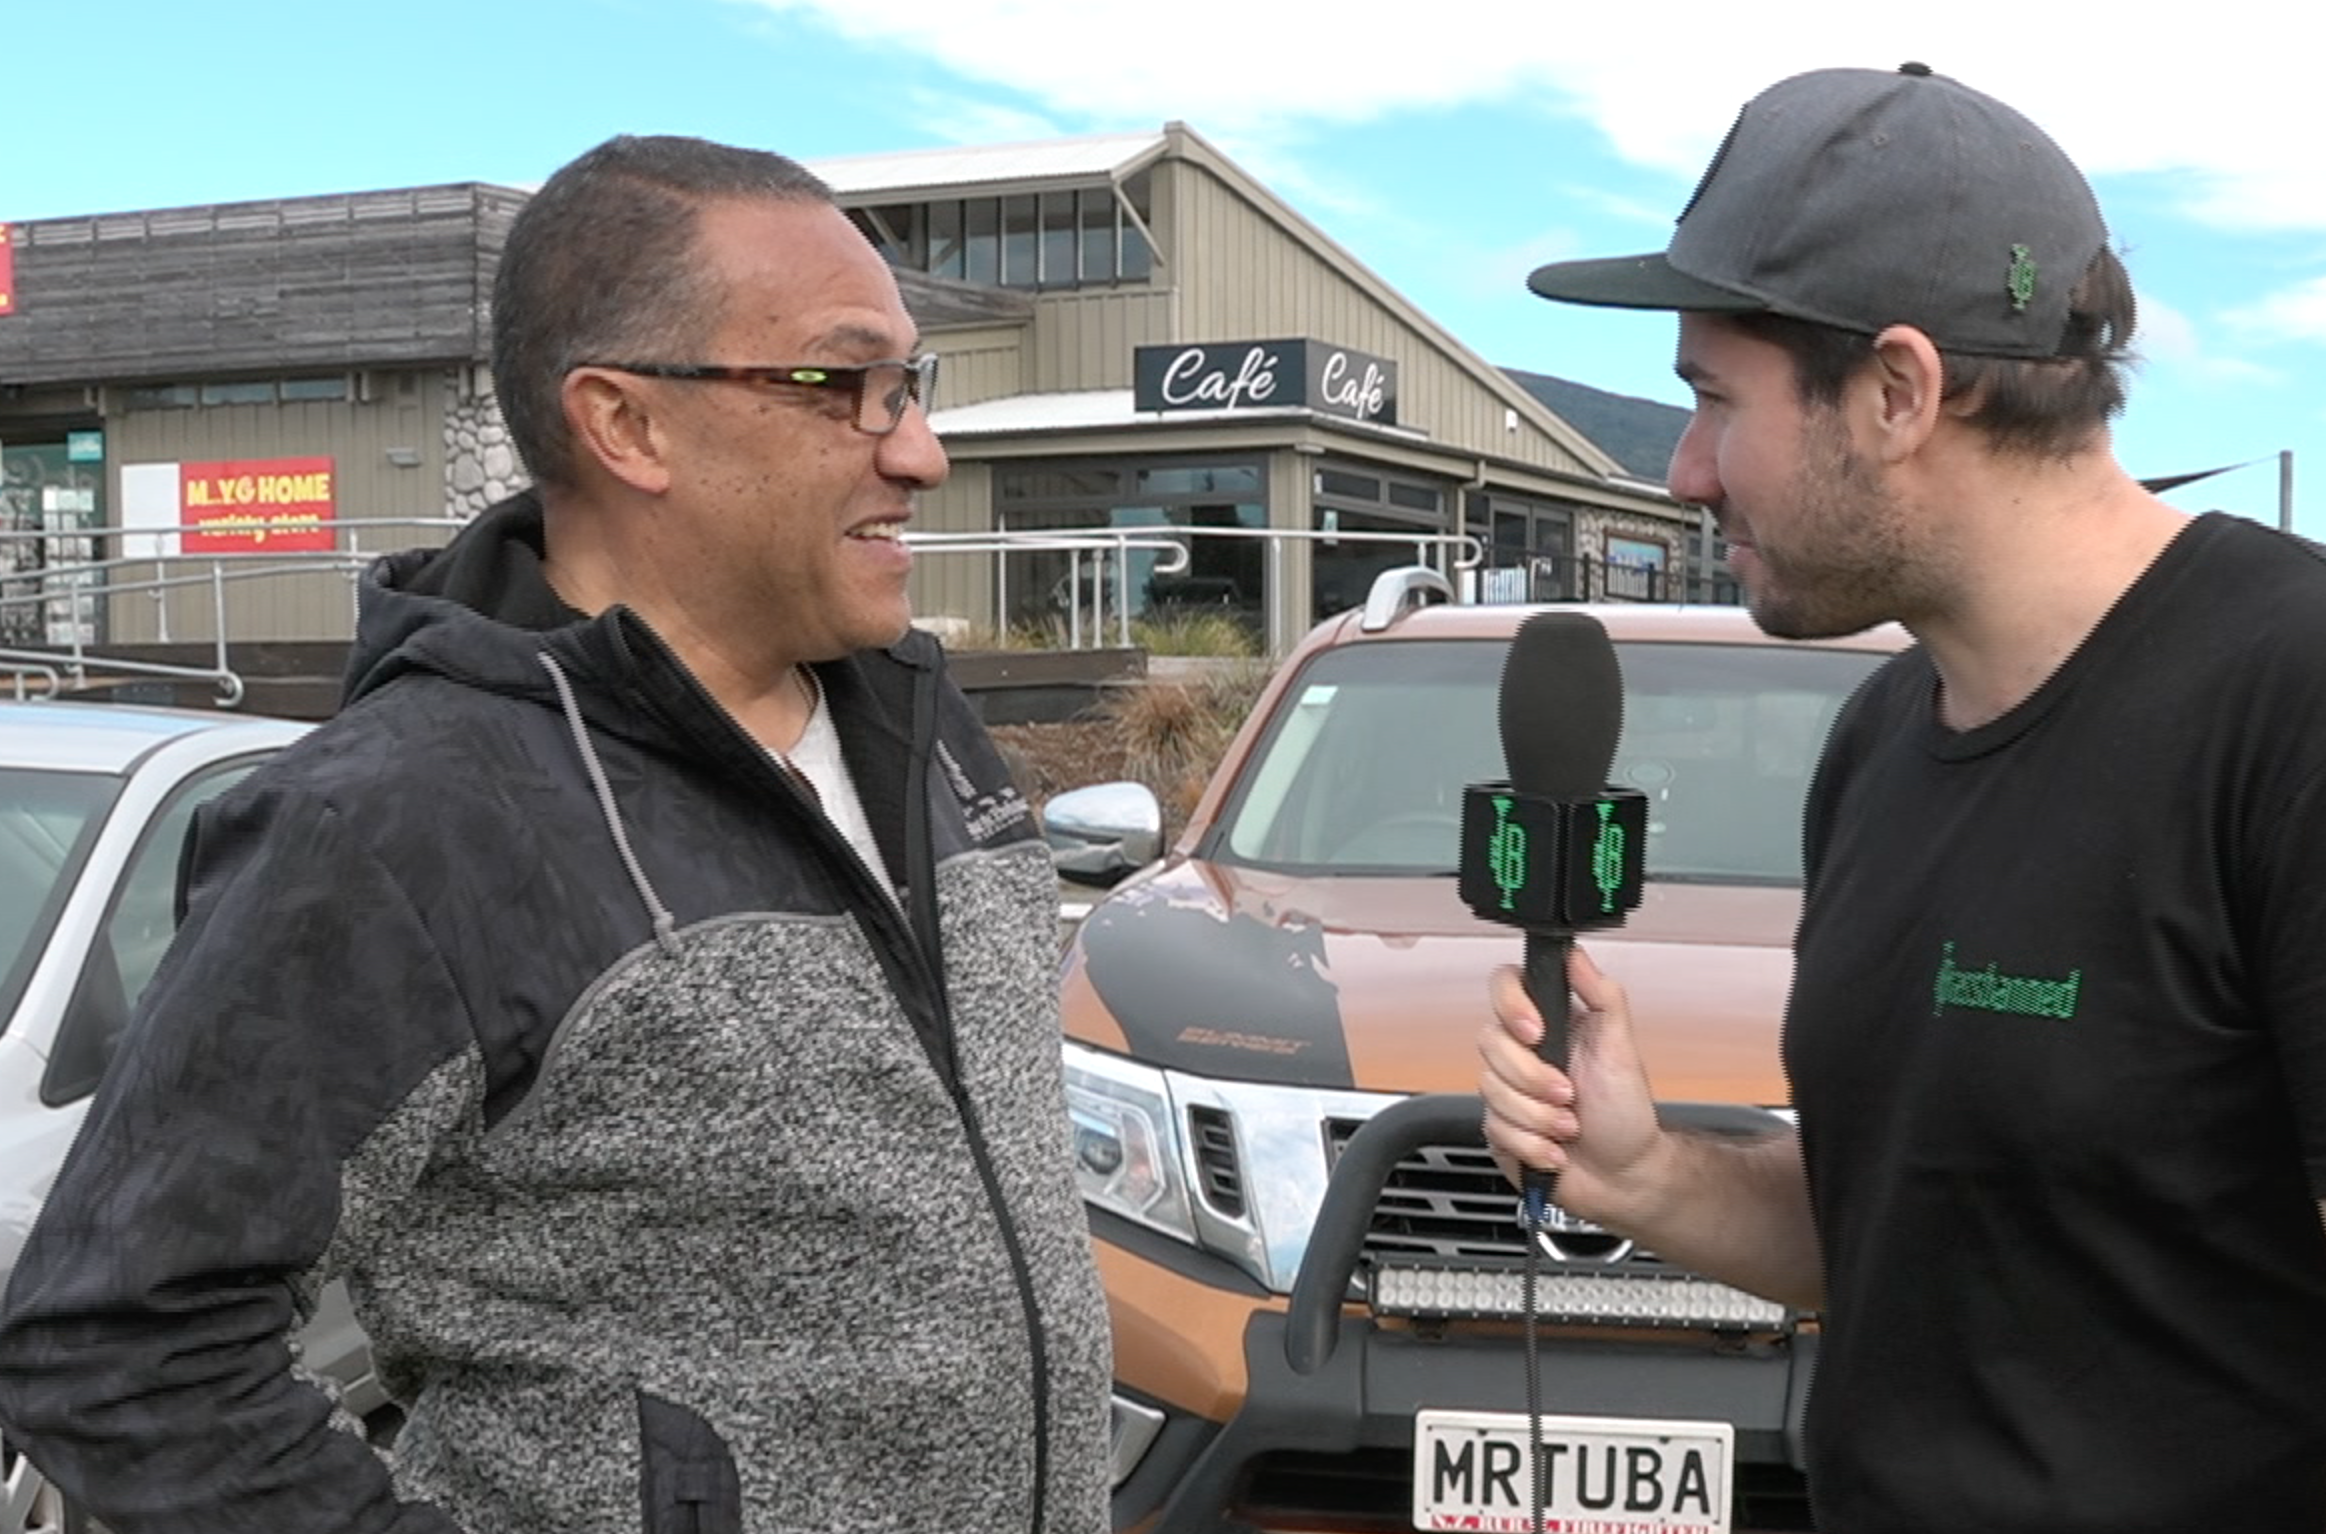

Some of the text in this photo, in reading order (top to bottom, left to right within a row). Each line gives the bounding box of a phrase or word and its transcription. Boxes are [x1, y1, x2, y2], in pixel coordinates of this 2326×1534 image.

[1162, 347, 1279, 411] Café
[1321, 352, 1386, 420] Café
[258, 472, 331, 504] HOME
[1433, 1439, 1711, 1515] MRTUBA
